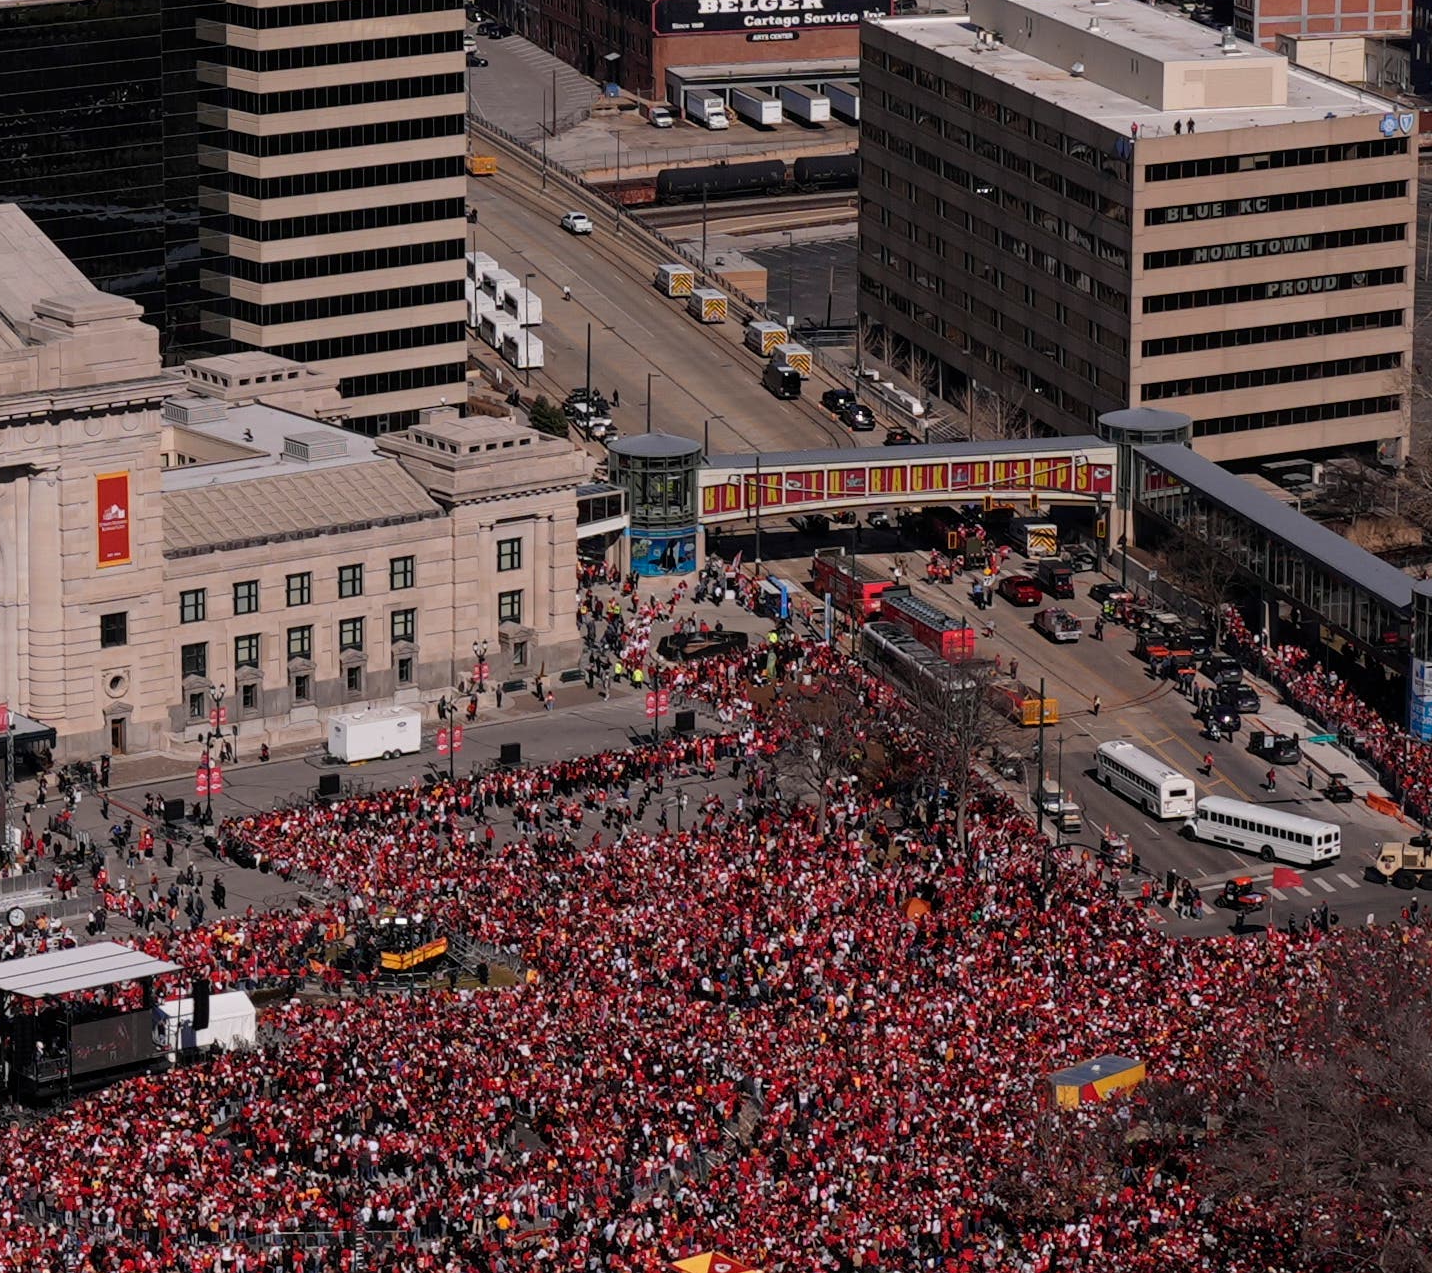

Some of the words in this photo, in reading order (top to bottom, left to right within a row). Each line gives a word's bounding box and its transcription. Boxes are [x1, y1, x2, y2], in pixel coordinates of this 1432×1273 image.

[754, 15, 811, 30] Cartage
[813, 10, 859, 24] Service
[753, 32, 778, 41] ARTS
[780, 31, 804, 40] CENTER
[1167, 203, 1223, 222] BLUE
[1240, 198, 1268, 214] KC
[1195, 236, 1311, 262] HOMETOWN
[1267, 275, 1338, 298] PROUD
[704, 473, 778, 511] BACK
[811, 470, 841, 495] TO
[871, 465, 945, 494] BACK
[975, 459, 1088, 492] CHAMPS
